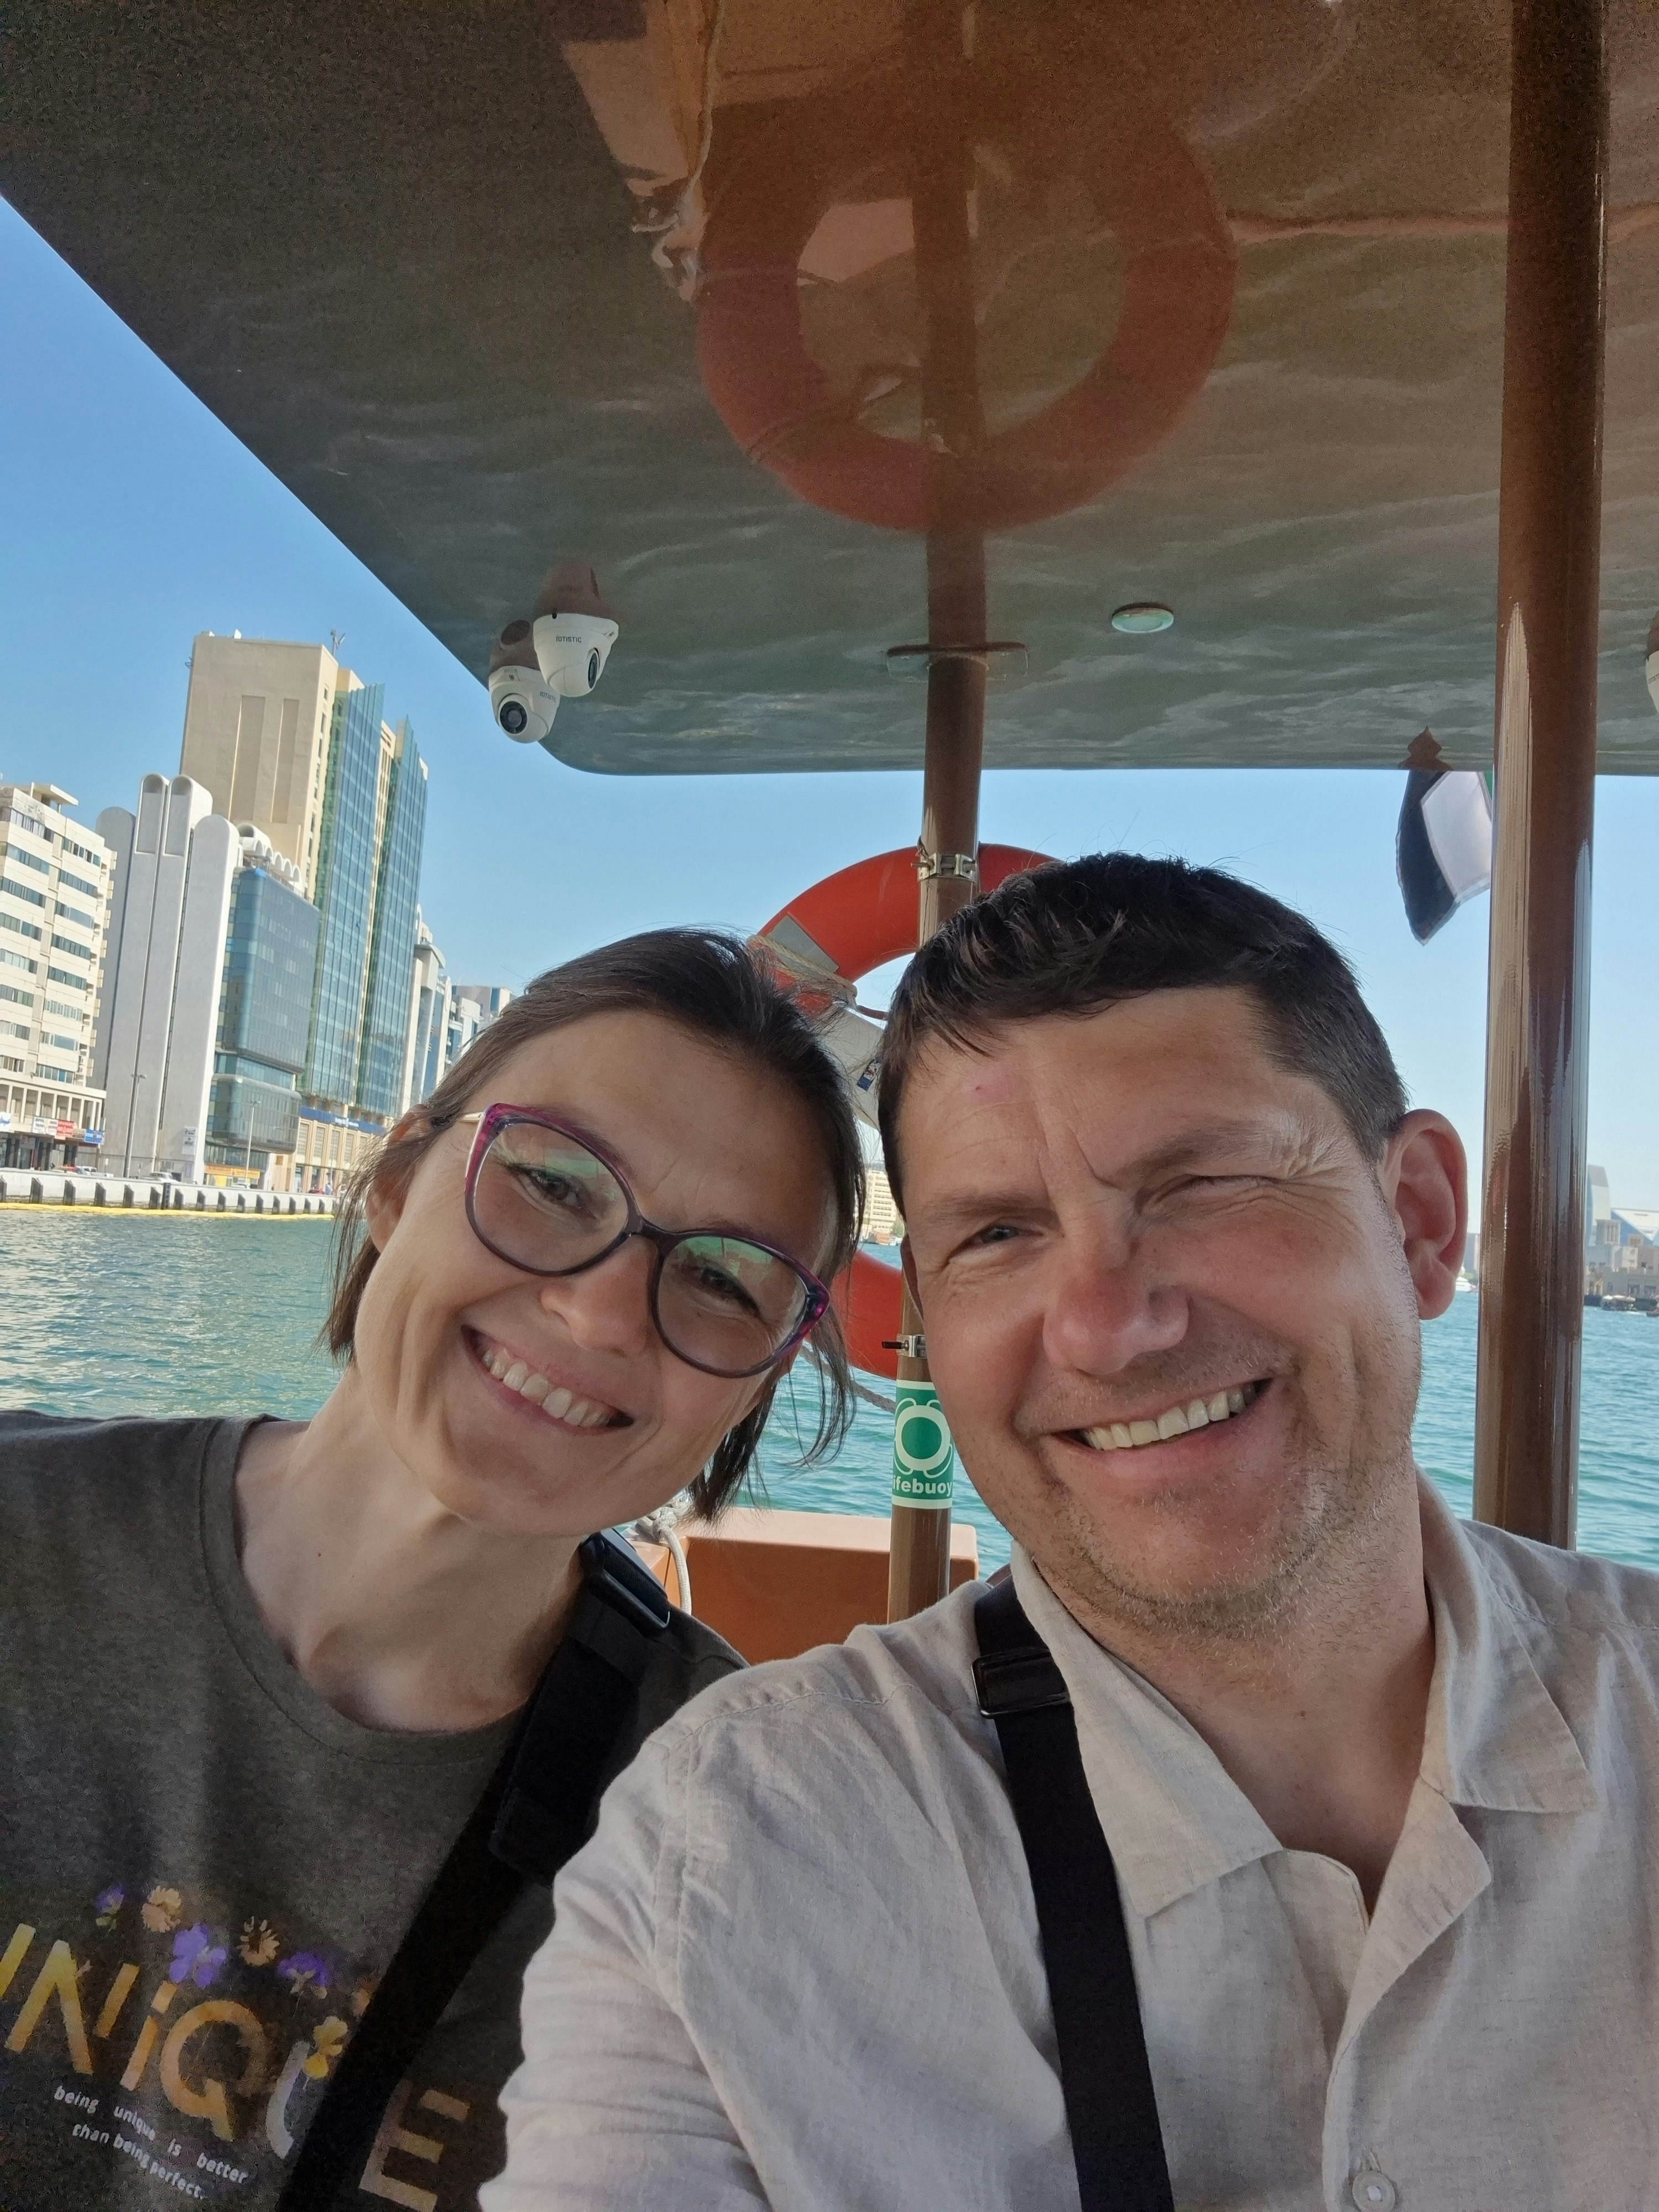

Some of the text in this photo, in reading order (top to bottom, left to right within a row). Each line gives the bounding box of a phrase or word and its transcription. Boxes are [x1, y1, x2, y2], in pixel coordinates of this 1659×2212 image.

[893, 1475, 952, 1497] ifebuoy
[54, 2085, 248, 2184] being unique is better
[72, 2124, 110, 2144] than
[113, 2133, 150, 2169] being
